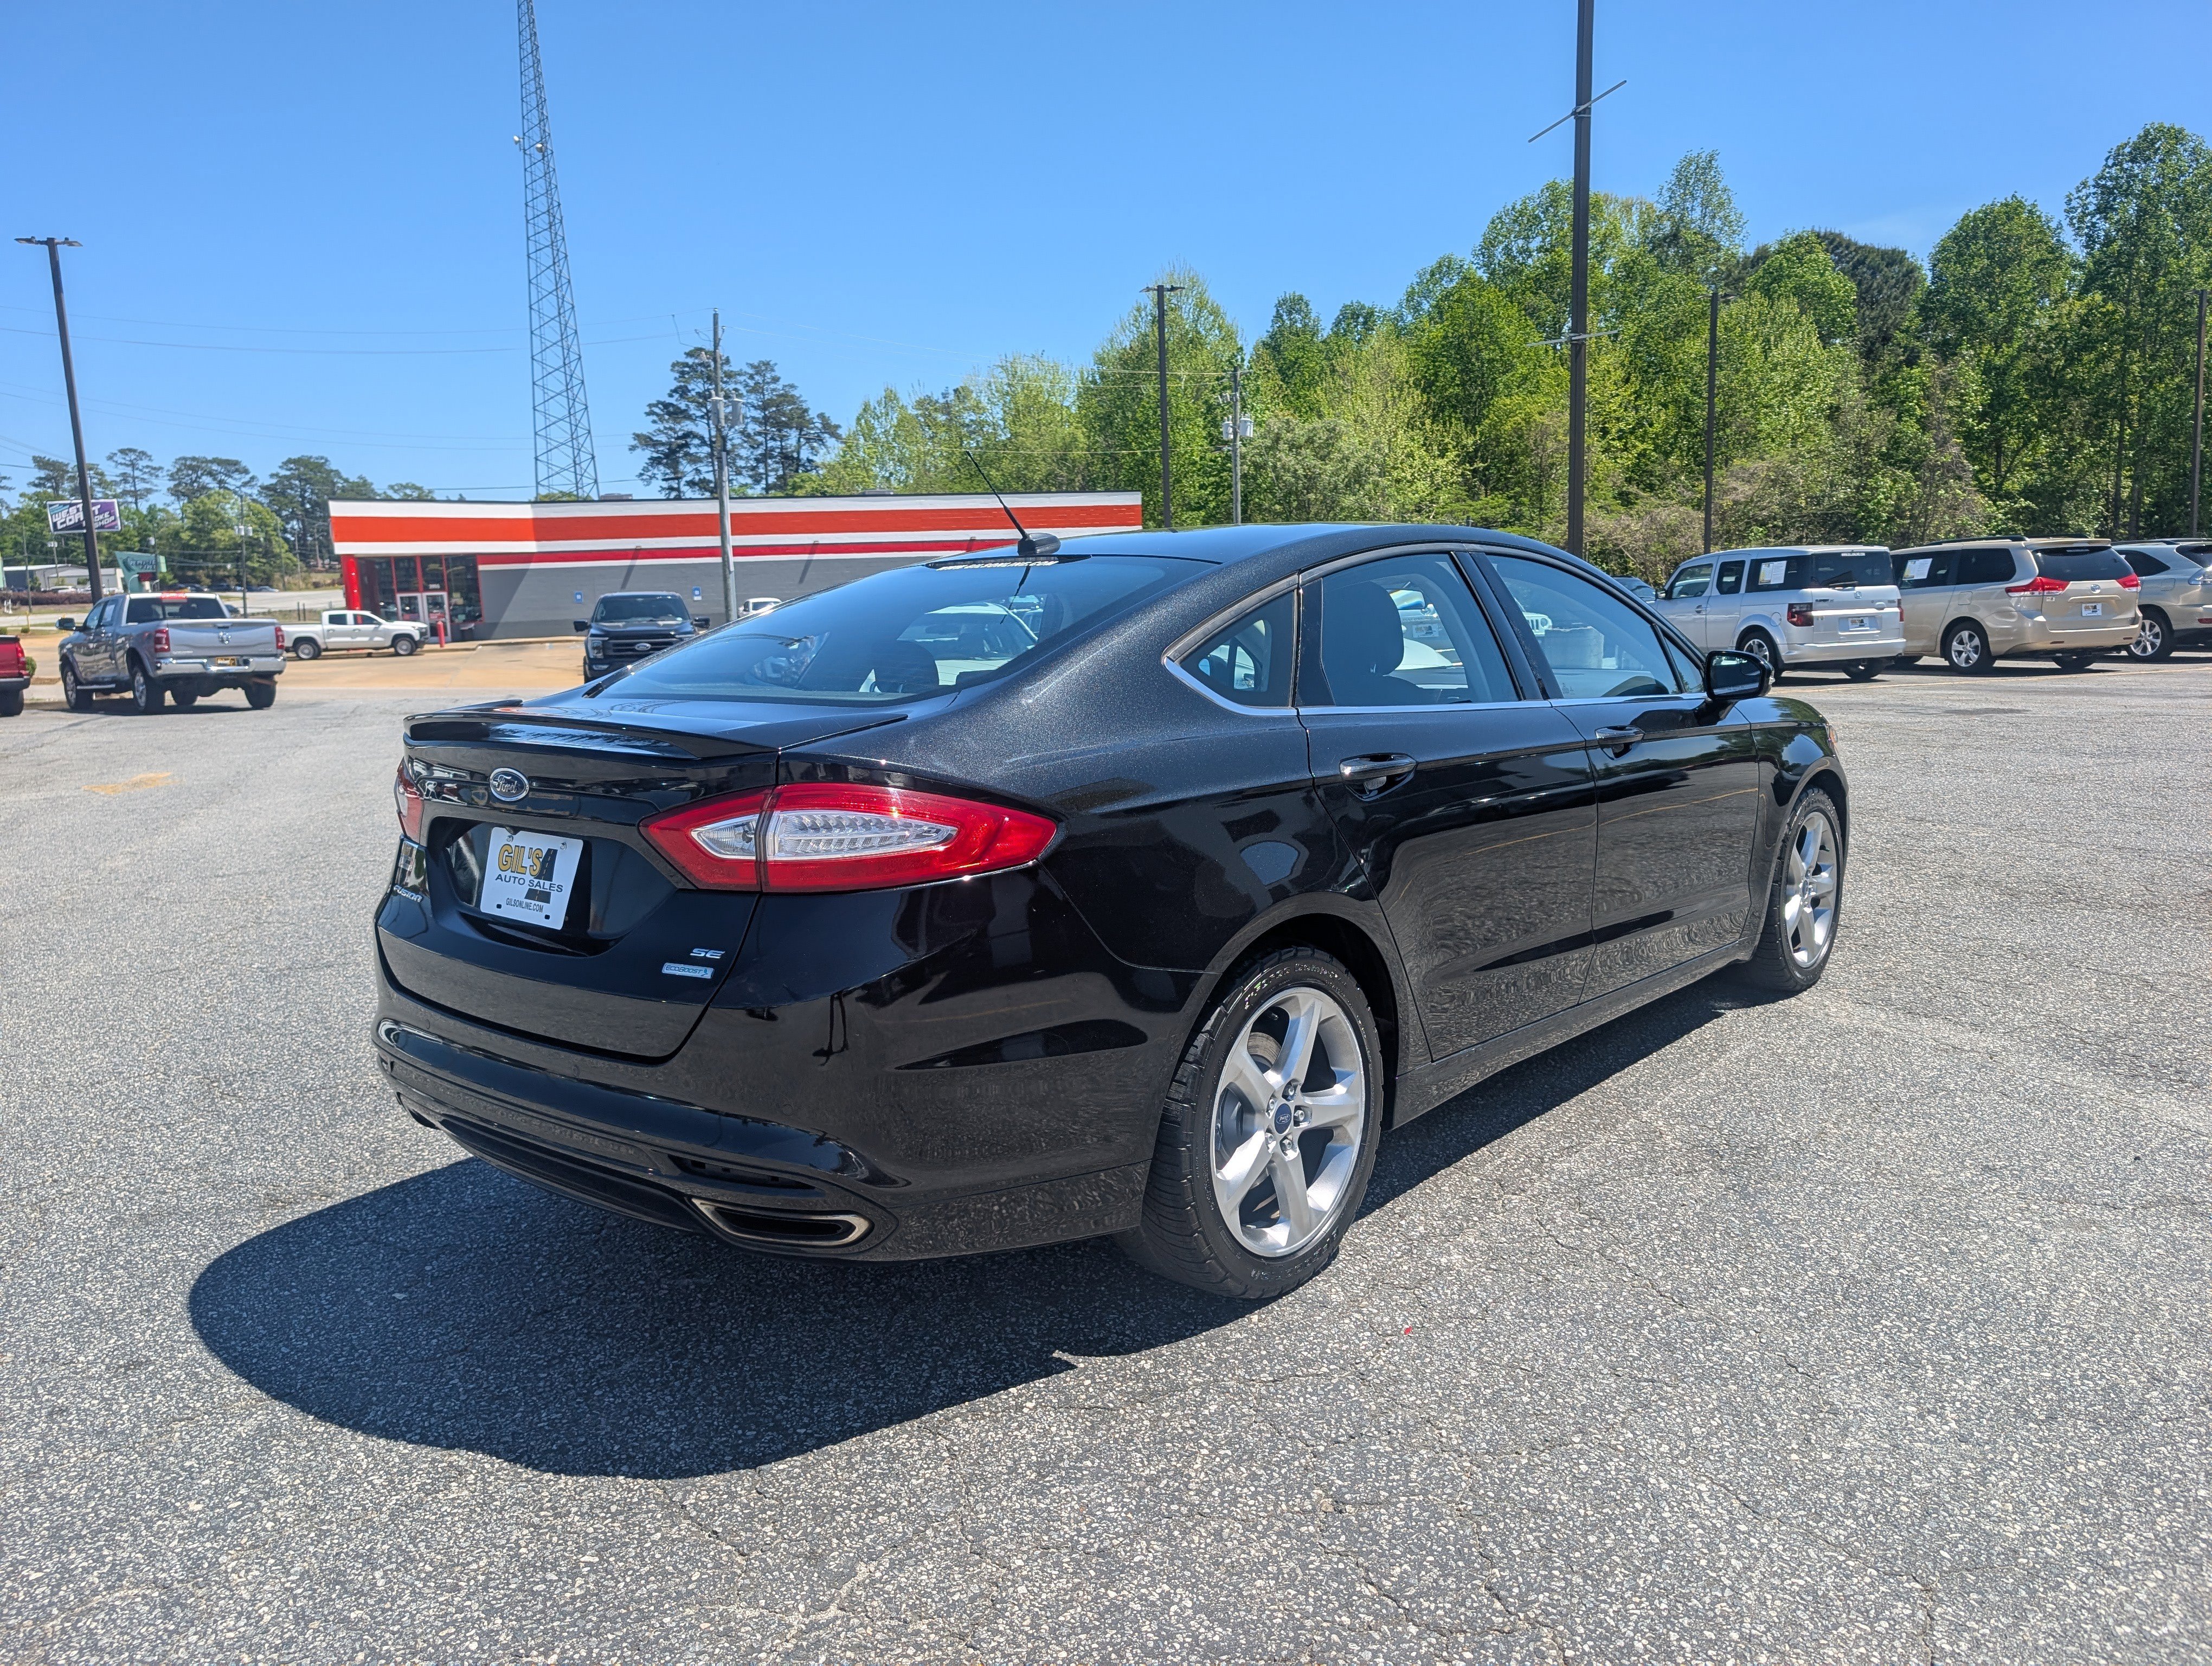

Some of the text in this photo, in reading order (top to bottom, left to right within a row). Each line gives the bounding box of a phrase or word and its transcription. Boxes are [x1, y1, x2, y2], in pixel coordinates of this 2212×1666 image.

[53, 503, 83, 522] WEST
[57, 504, 101, 530] COAT
[494, 774, 518, 793] Ford
[498, 843, 543, 877] GIL'S
[495, 874, 563, 893] AUTO SALES
[506, 898, 544, 913] GILSONLINE.COM
[690, 948, 725, 959] SE
